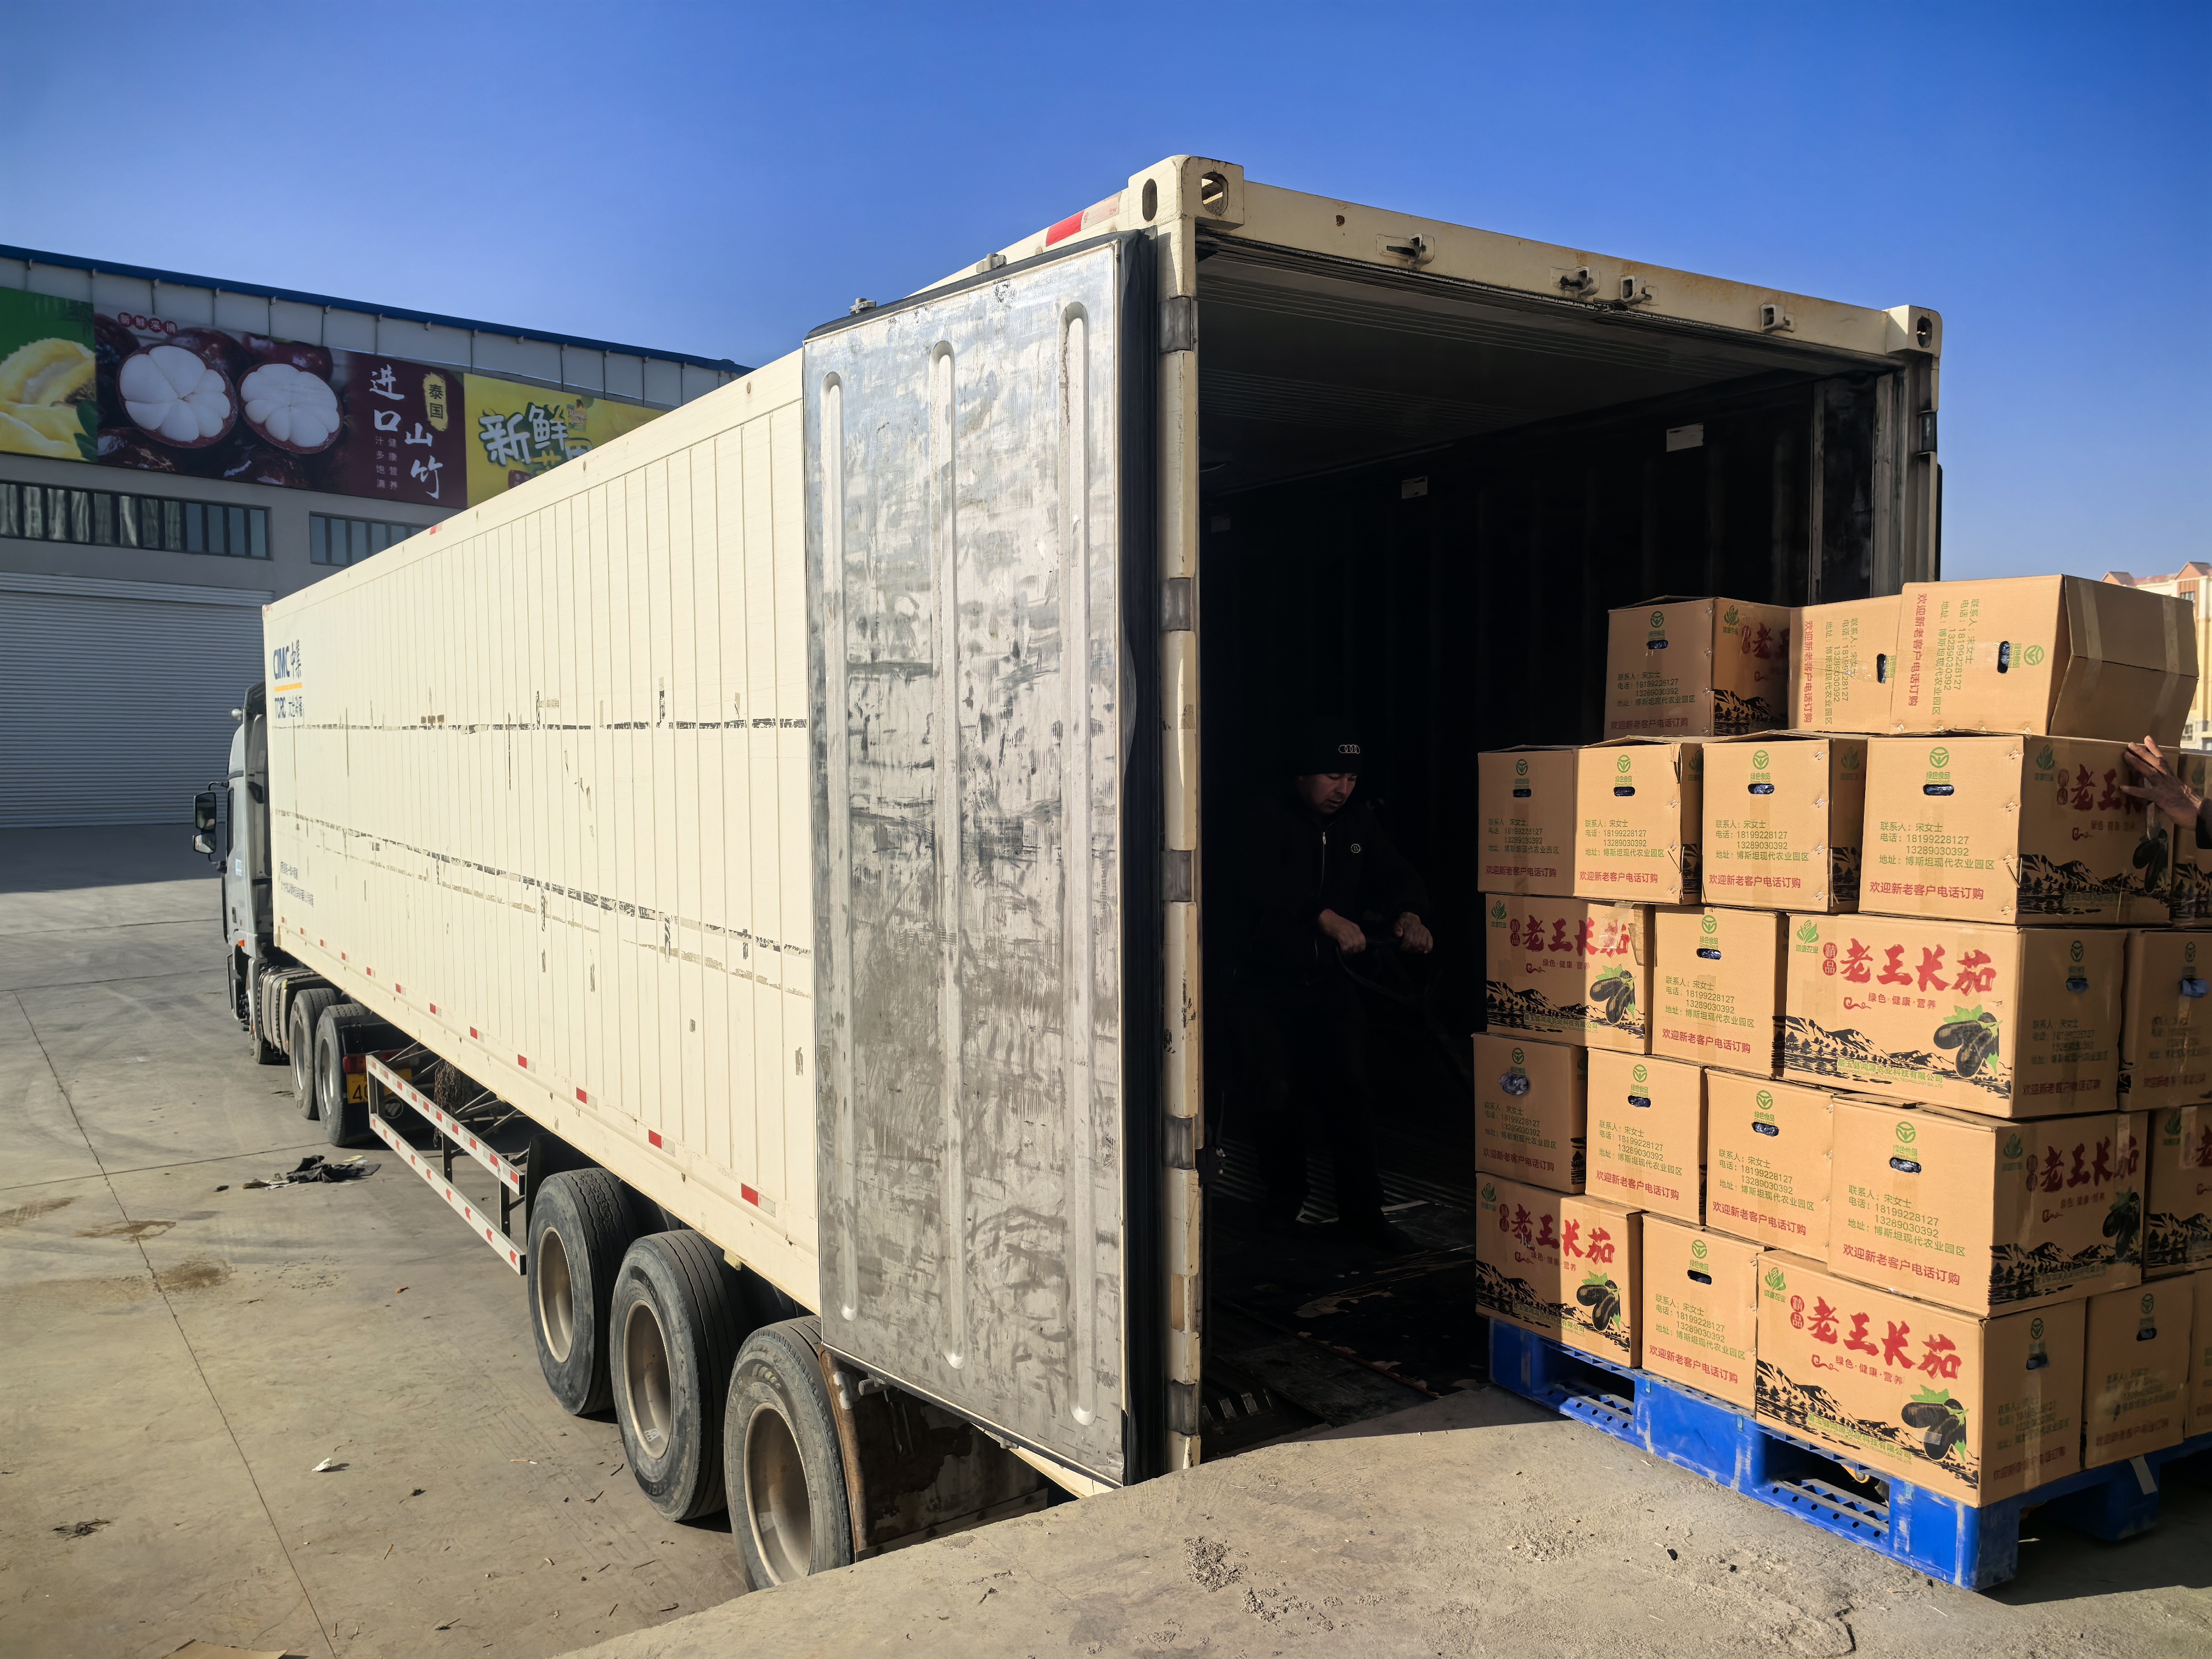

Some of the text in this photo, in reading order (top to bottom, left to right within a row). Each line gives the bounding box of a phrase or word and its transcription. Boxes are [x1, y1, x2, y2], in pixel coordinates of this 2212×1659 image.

[429, 384, 443, 419] 泰国
[480, 405, 568, 465] 新鲜
[273, 639, 301, 680] CIMC 中集
[1908, 593, 1927, 706] 欢迎新老客户电话订购
[1944, 628, 1956, 690] 13289030392
[1804, 621, 1813, 723] 欢迎新老客户电话订购
[1737, 841, 1788, 850] 13289030392
[1906, 846, 1969, 857] 13289030392
[1486, 865, 1556, 878] 欢迎新老客户电话订购
[1580, 870, 1658, 884] 欢迎新老客户电话订购
[1709, 874, 1801, 888] 欢迎新老客户电话订购
[1870, 881, 1984, 900] 欢迎新老客户电话订购
[1522, 914, 1630, 958] 老王长茄
[1824, 943, 1837, 975] 精品
[1840, 938, 1997, 996] 老王长茄
[1686, 999, 1735, 1014] 13289030392
[1662, 1028, 1750, 1053] 欢迎新老客户电话订购
[1501, 1122, 1540, 1137] 13289030392
[1483, 1148, 1554, 1172] 欢迎新老客户电话订购
[1618, 1144, 1663, 1161] 13289030392
[1596, 1170, 1679, 1201] 欢迎新老客户电话订购
[1742, 1175, 1793, 1195] 13289030392
[1511, 1203, 1615, 1265] 老王长茄
[1712, 1201, 1806, 1236] 欢迎新老客户电话订购
[1875, 1214, 1939, 1238] 13289030392
[1843, 1243, 1960, 1286] 欢迎新老客户电话订购
[1791, 1296, 1804, 1328] 精品
[1676, 1321, 1725, 1343] 13289030392
[1807, 1296, 1961, 1380] 老王长茄
[1649, 1345, 1738, 1384] 欢迎新老客户电话订购
